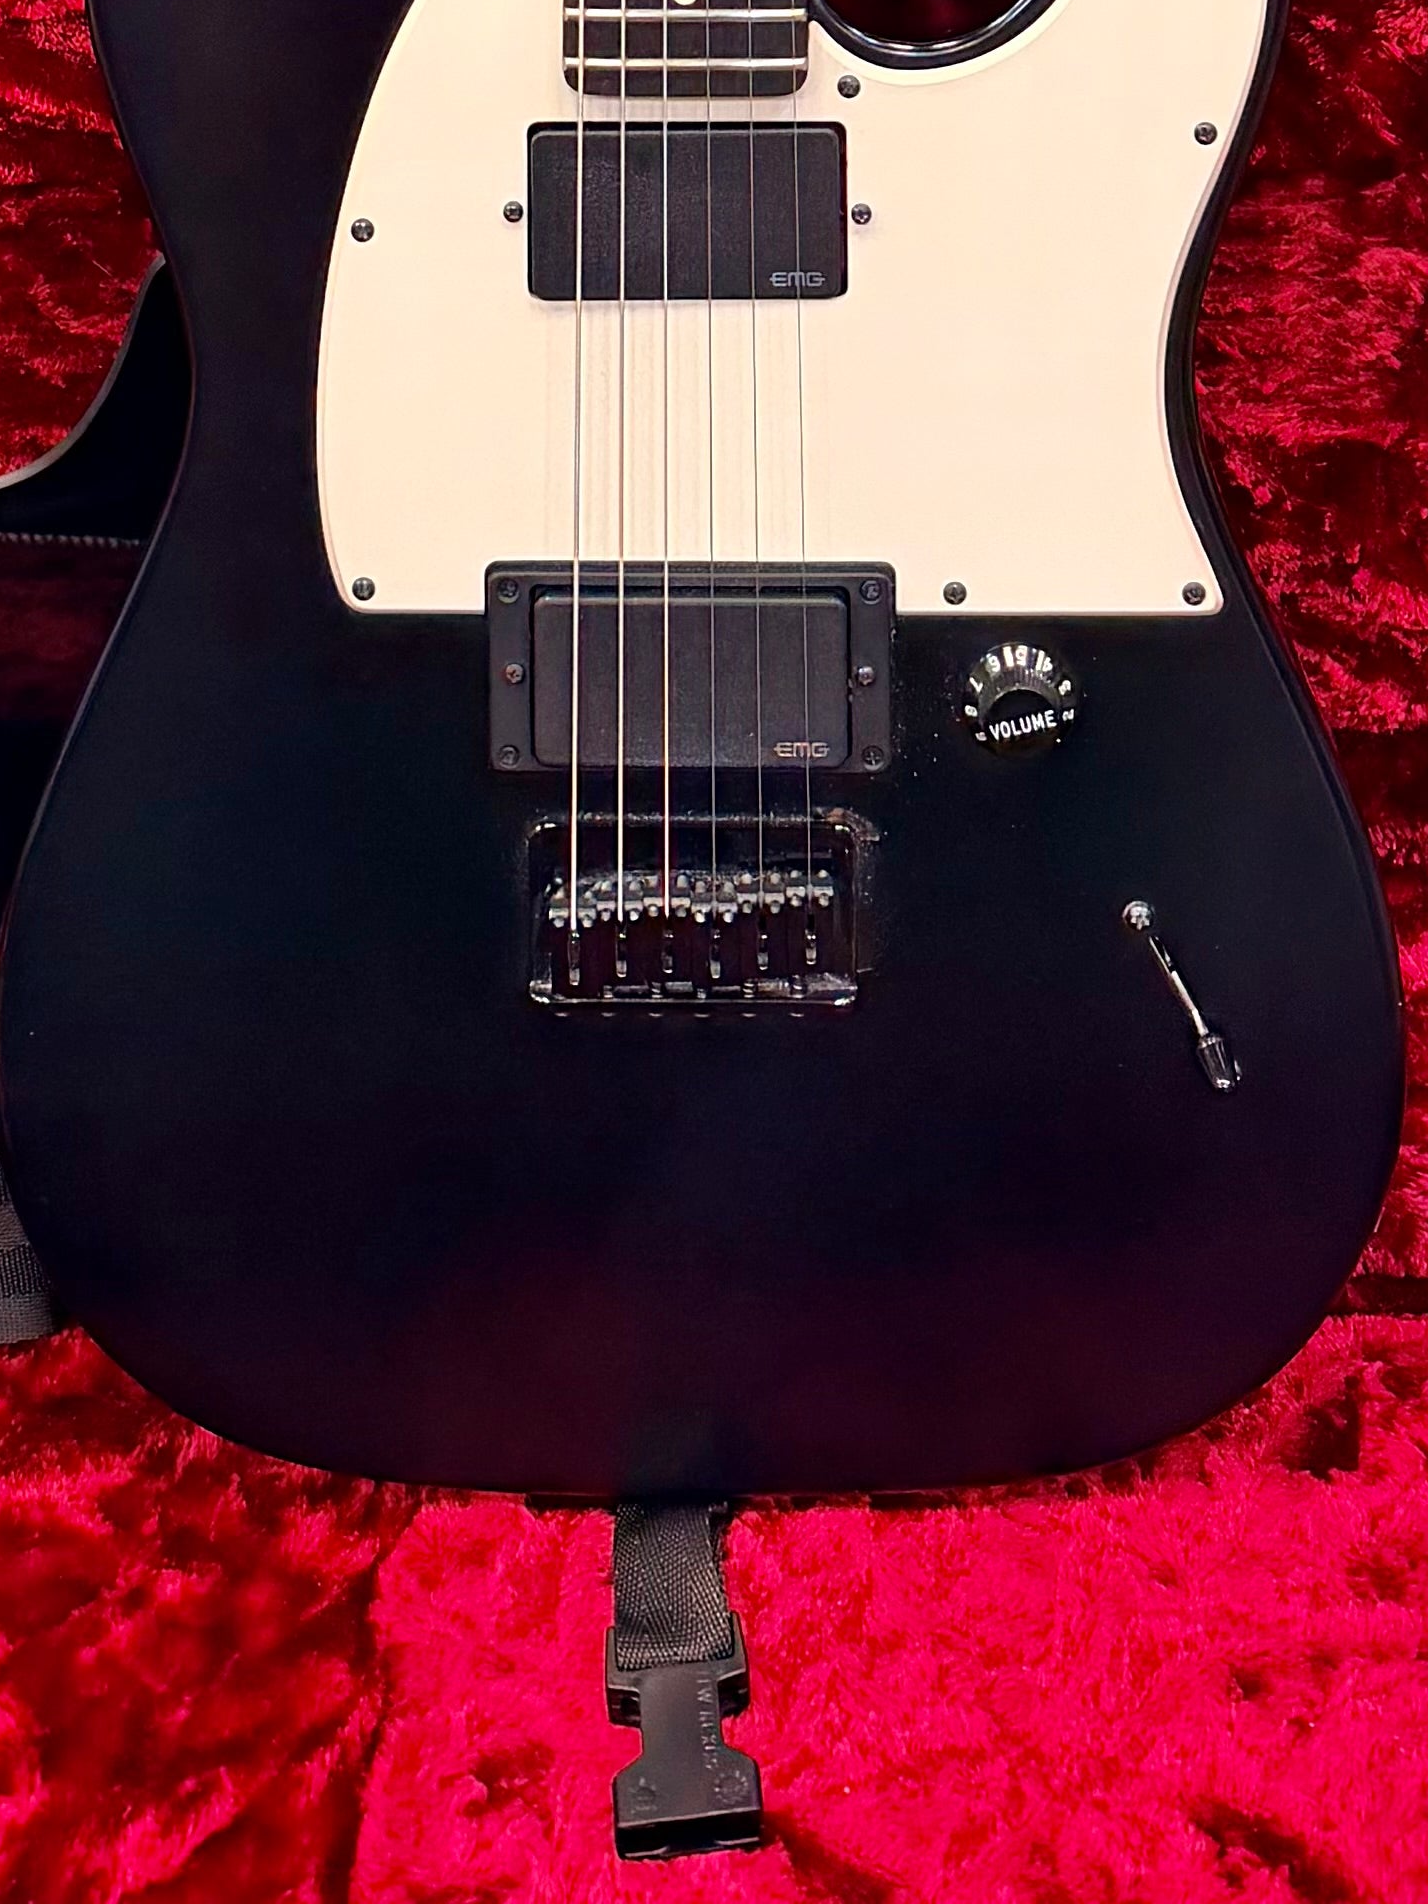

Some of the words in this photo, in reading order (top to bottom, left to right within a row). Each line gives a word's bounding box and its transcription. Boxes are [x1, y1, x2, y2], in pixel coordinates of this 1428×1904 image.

[769, 271, 826, 288] EMG
[988, 709, 1058, 741] VOLUME
[773, 741, 831, 758] EMG
